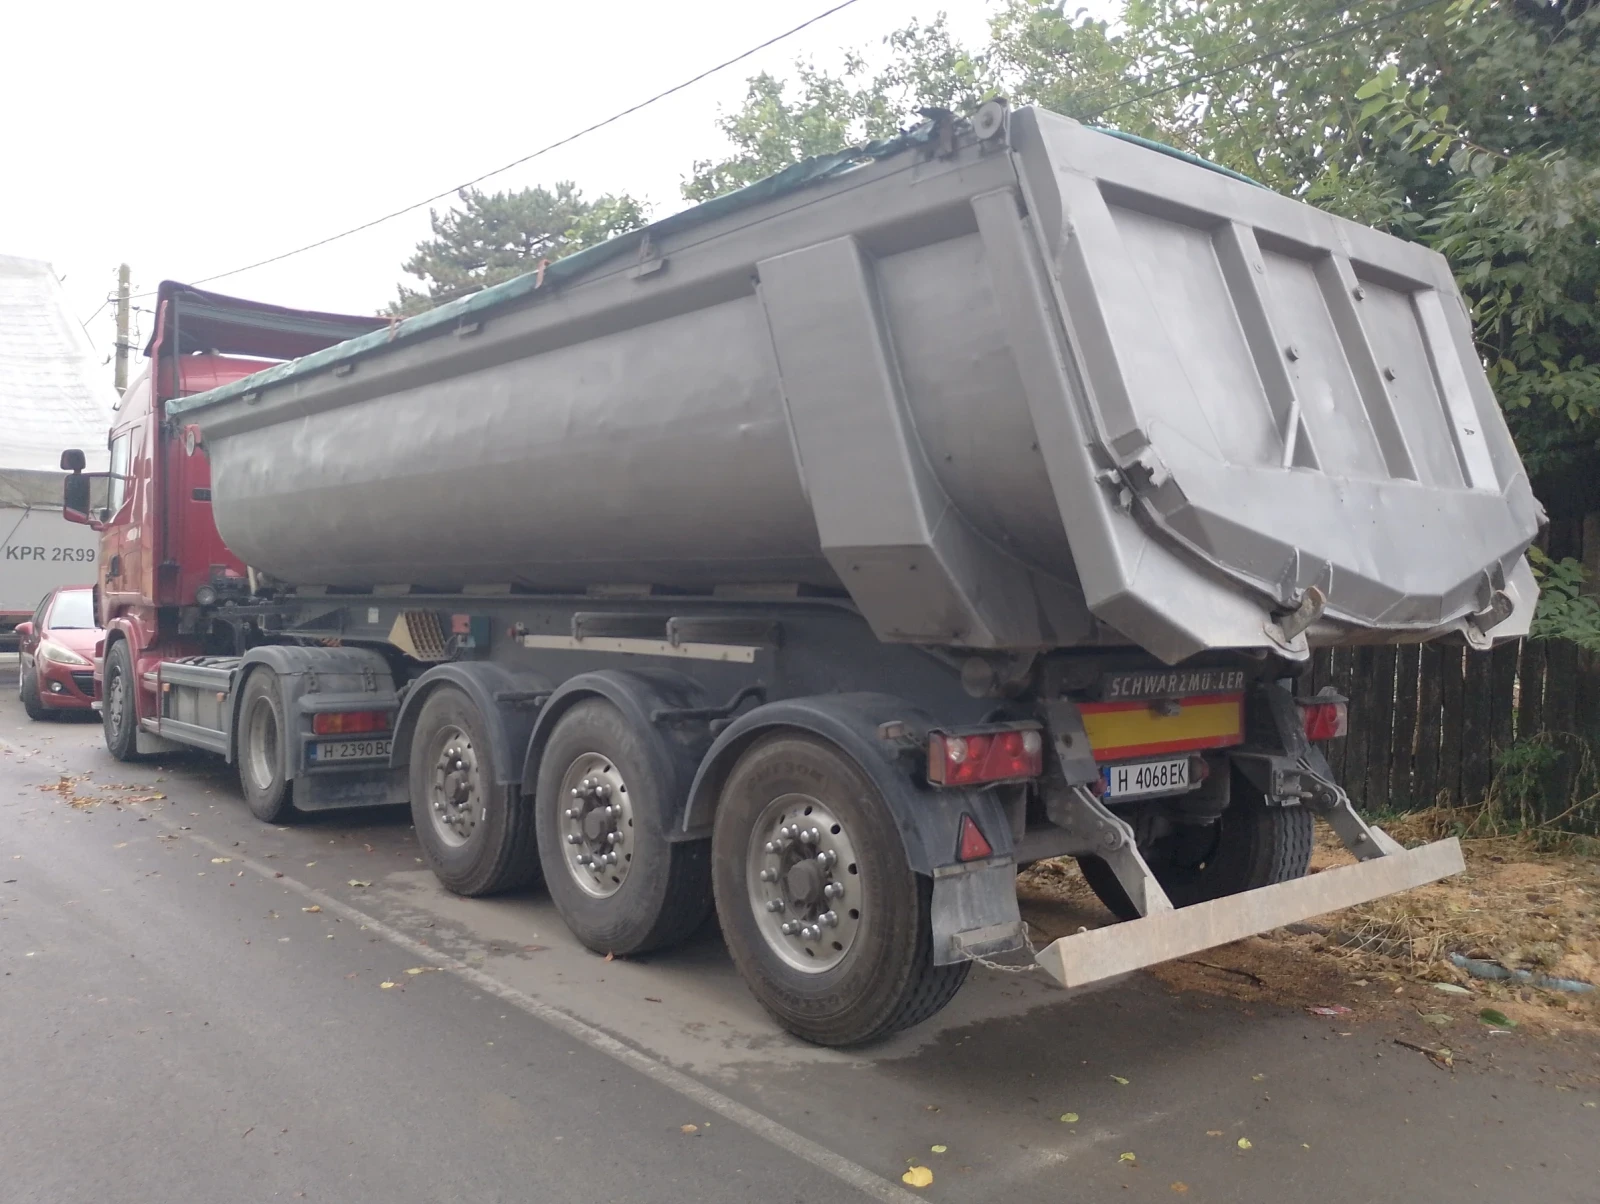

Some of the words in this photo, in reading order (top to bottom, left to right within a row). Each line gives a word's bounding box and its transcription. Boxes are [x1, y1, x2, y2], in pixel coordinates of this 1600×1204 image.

[6, 545, 46, 561] KPR
[51, 547, 95, 562] 2R99
[1110, 671, 1244, 697] SCHWARZMÜLER
[324, 744, 333, 758] H
[341, 743, 373, 757] 2390
[1118, 769, 1128, 792] H
